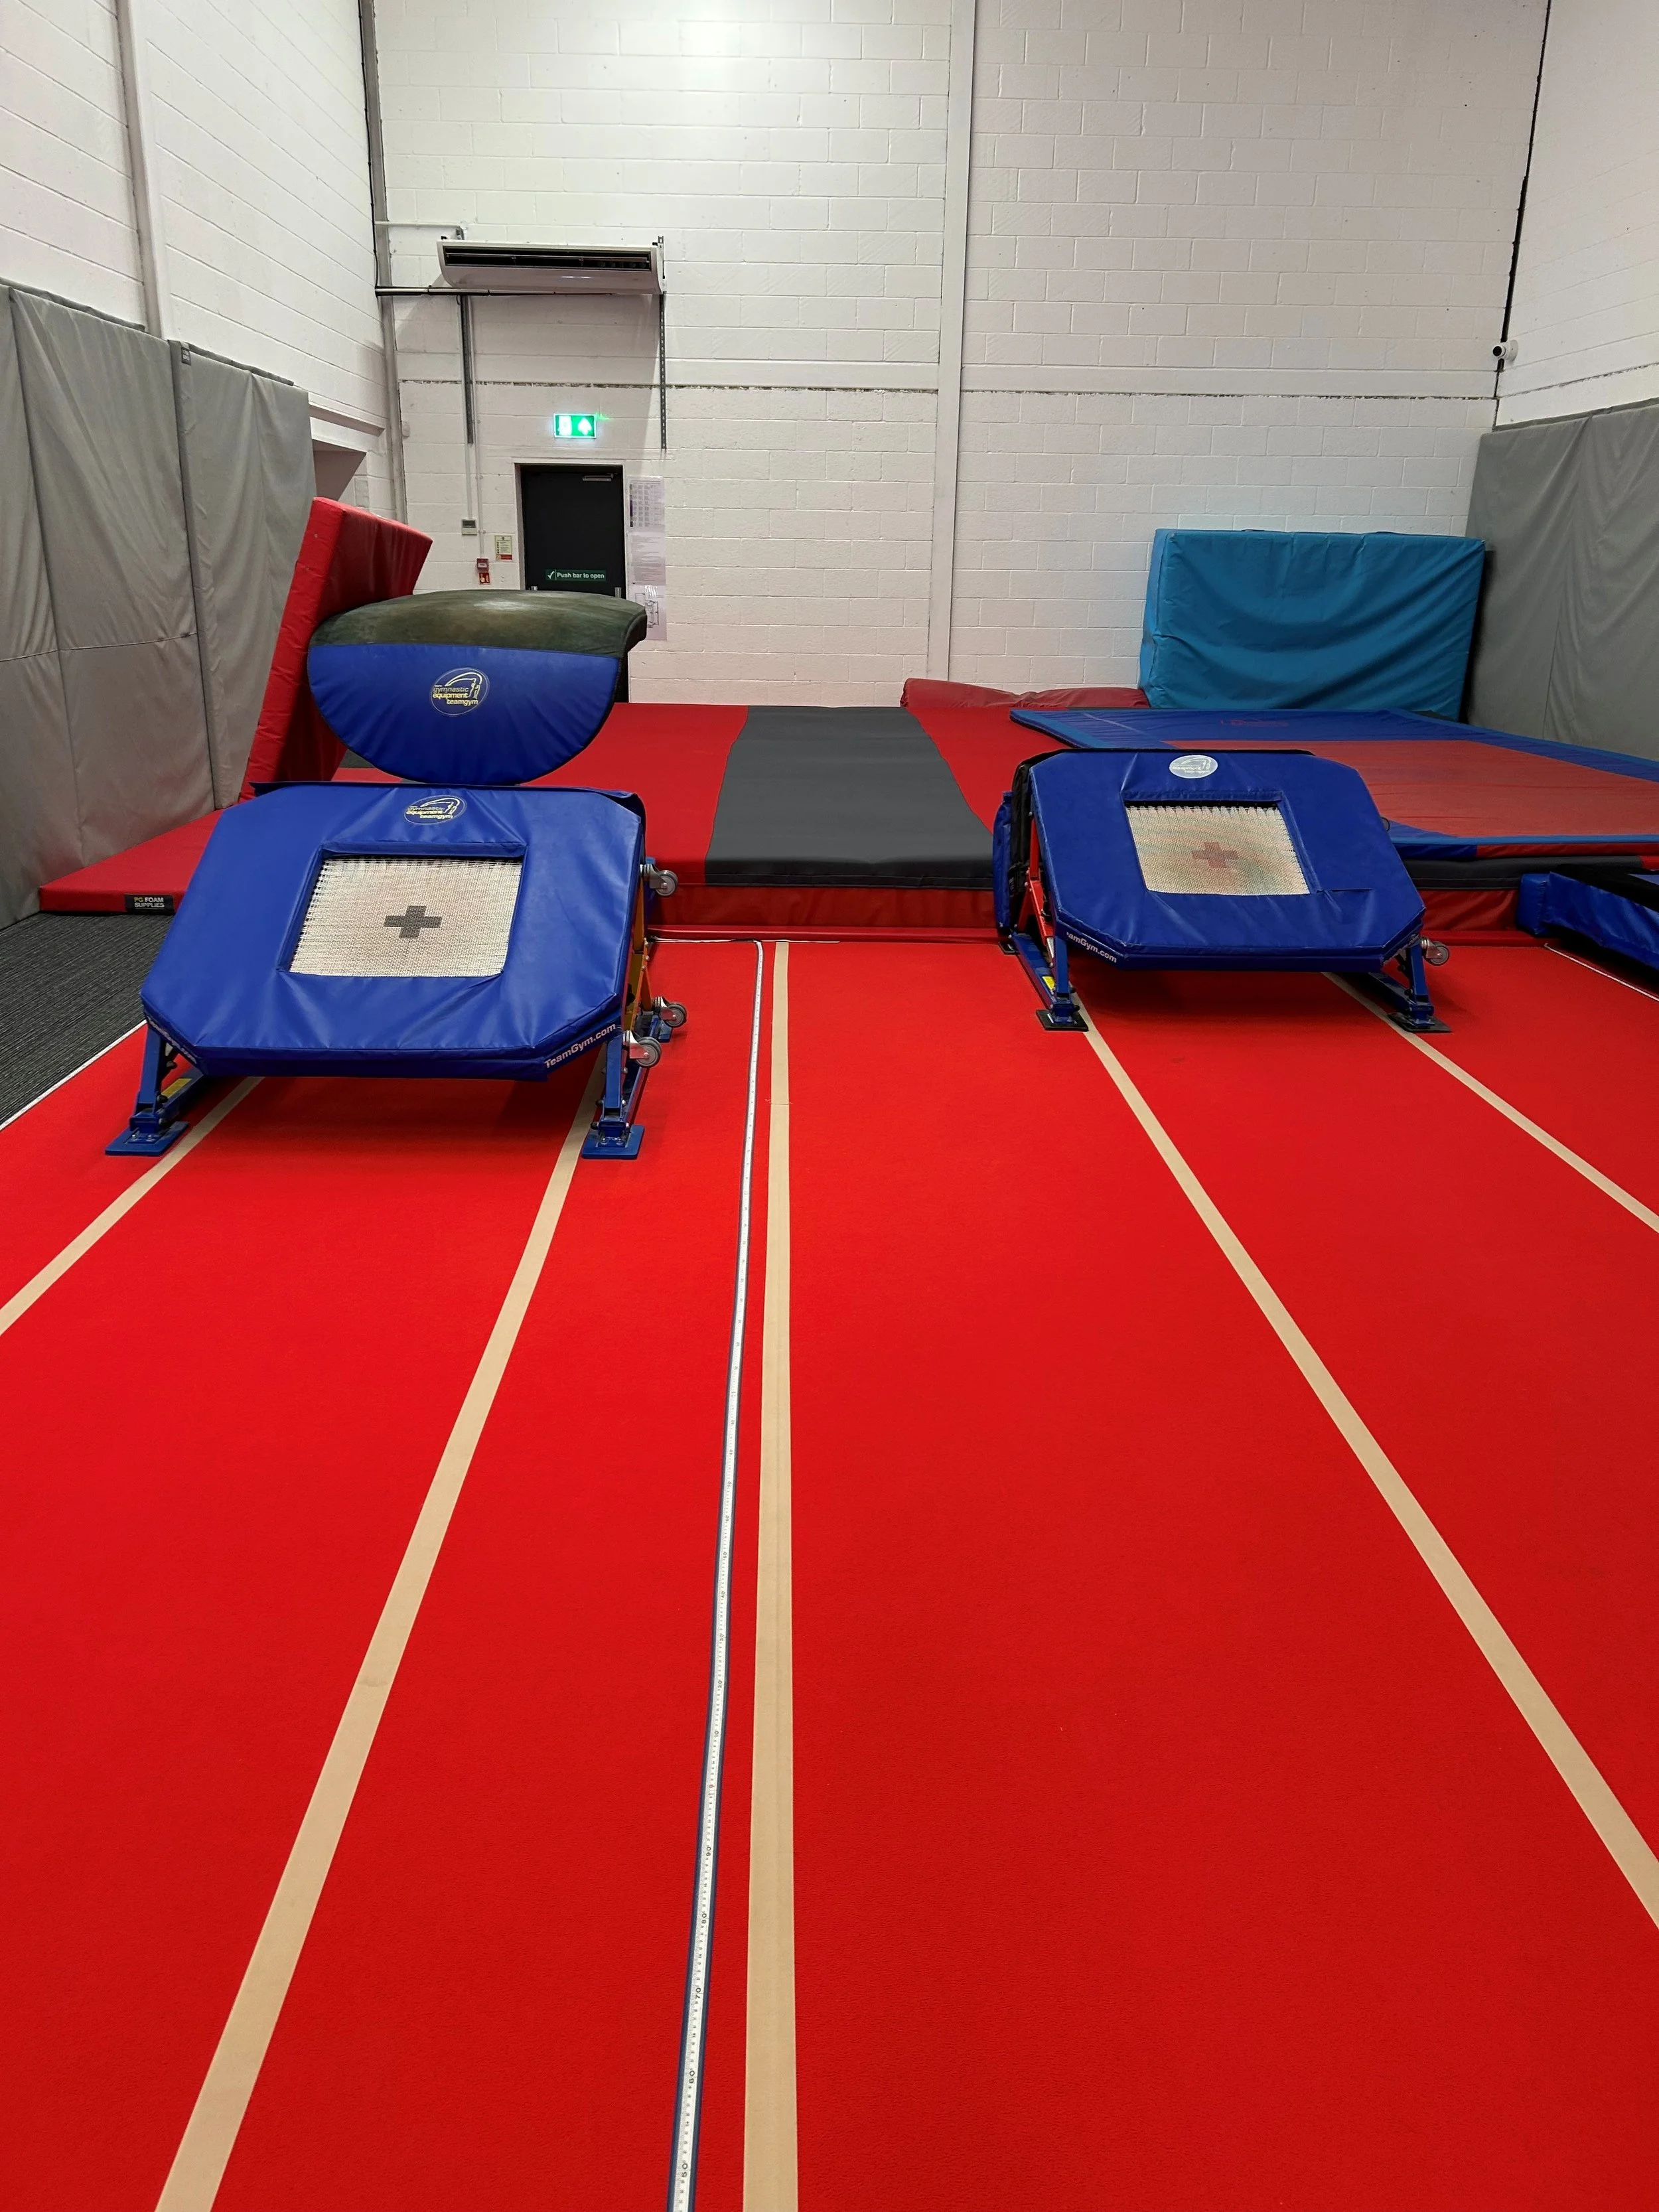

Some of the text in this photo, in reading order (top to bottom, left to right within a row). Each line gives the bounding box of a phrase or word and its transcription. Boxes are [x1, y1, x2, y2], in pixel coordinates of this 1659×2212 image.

[1066, 931, 1118, 963] amGym.com
[544, 1023, 616, 1069] TeamGym.com
[706, 1846, 711, 1856] 90
[701, 1913, 707, 1924] 80
[695, 1987, 701, 2000] 70
[689, 2070, 695, 2084] 60
[682, 2163, 688, 2177] 50
